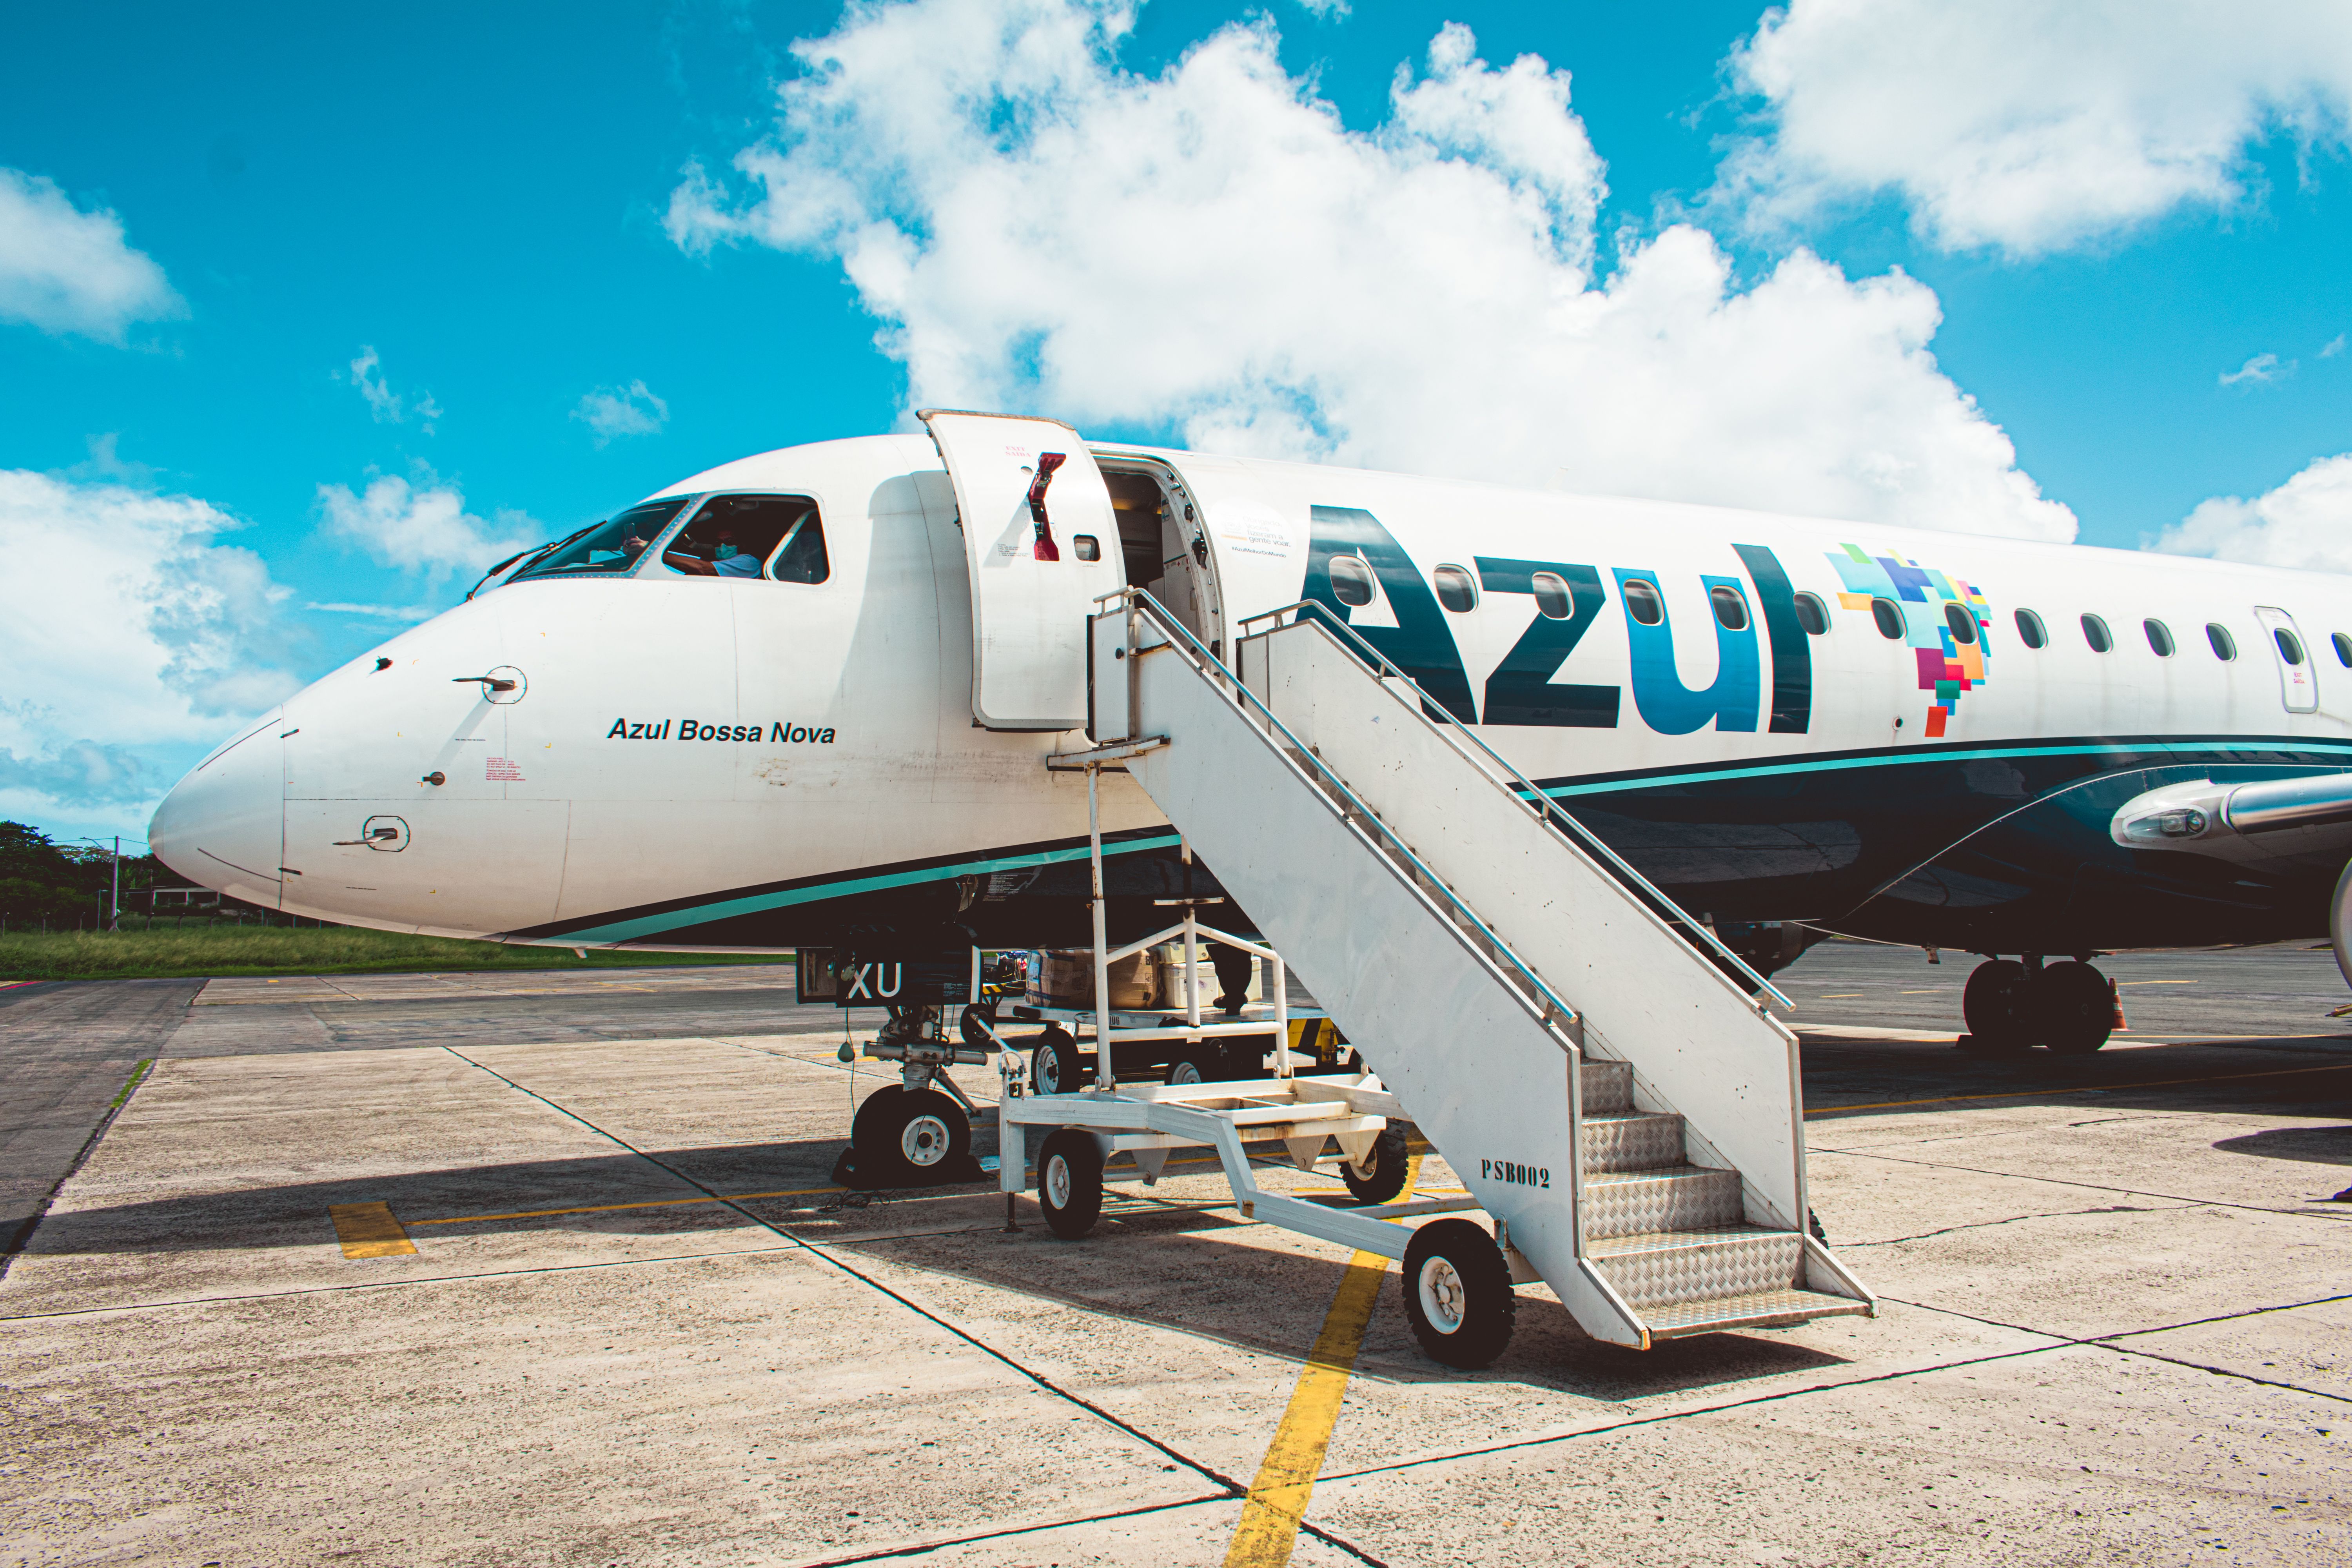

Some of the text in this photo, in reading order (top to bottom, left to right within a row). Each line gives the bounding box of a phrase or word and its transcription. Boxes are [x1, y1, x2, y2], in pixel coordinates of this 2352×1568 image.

[1247, 530, 1276, 539] fizeram
[1232, 546, 1286, 558] #AzulMelhorDoMundo
[606, 718, 835, 744] Azul Bossa Nova
[848, 962, 901, 999] XU
[1481, 1159, 1550, 1189] PSB002
